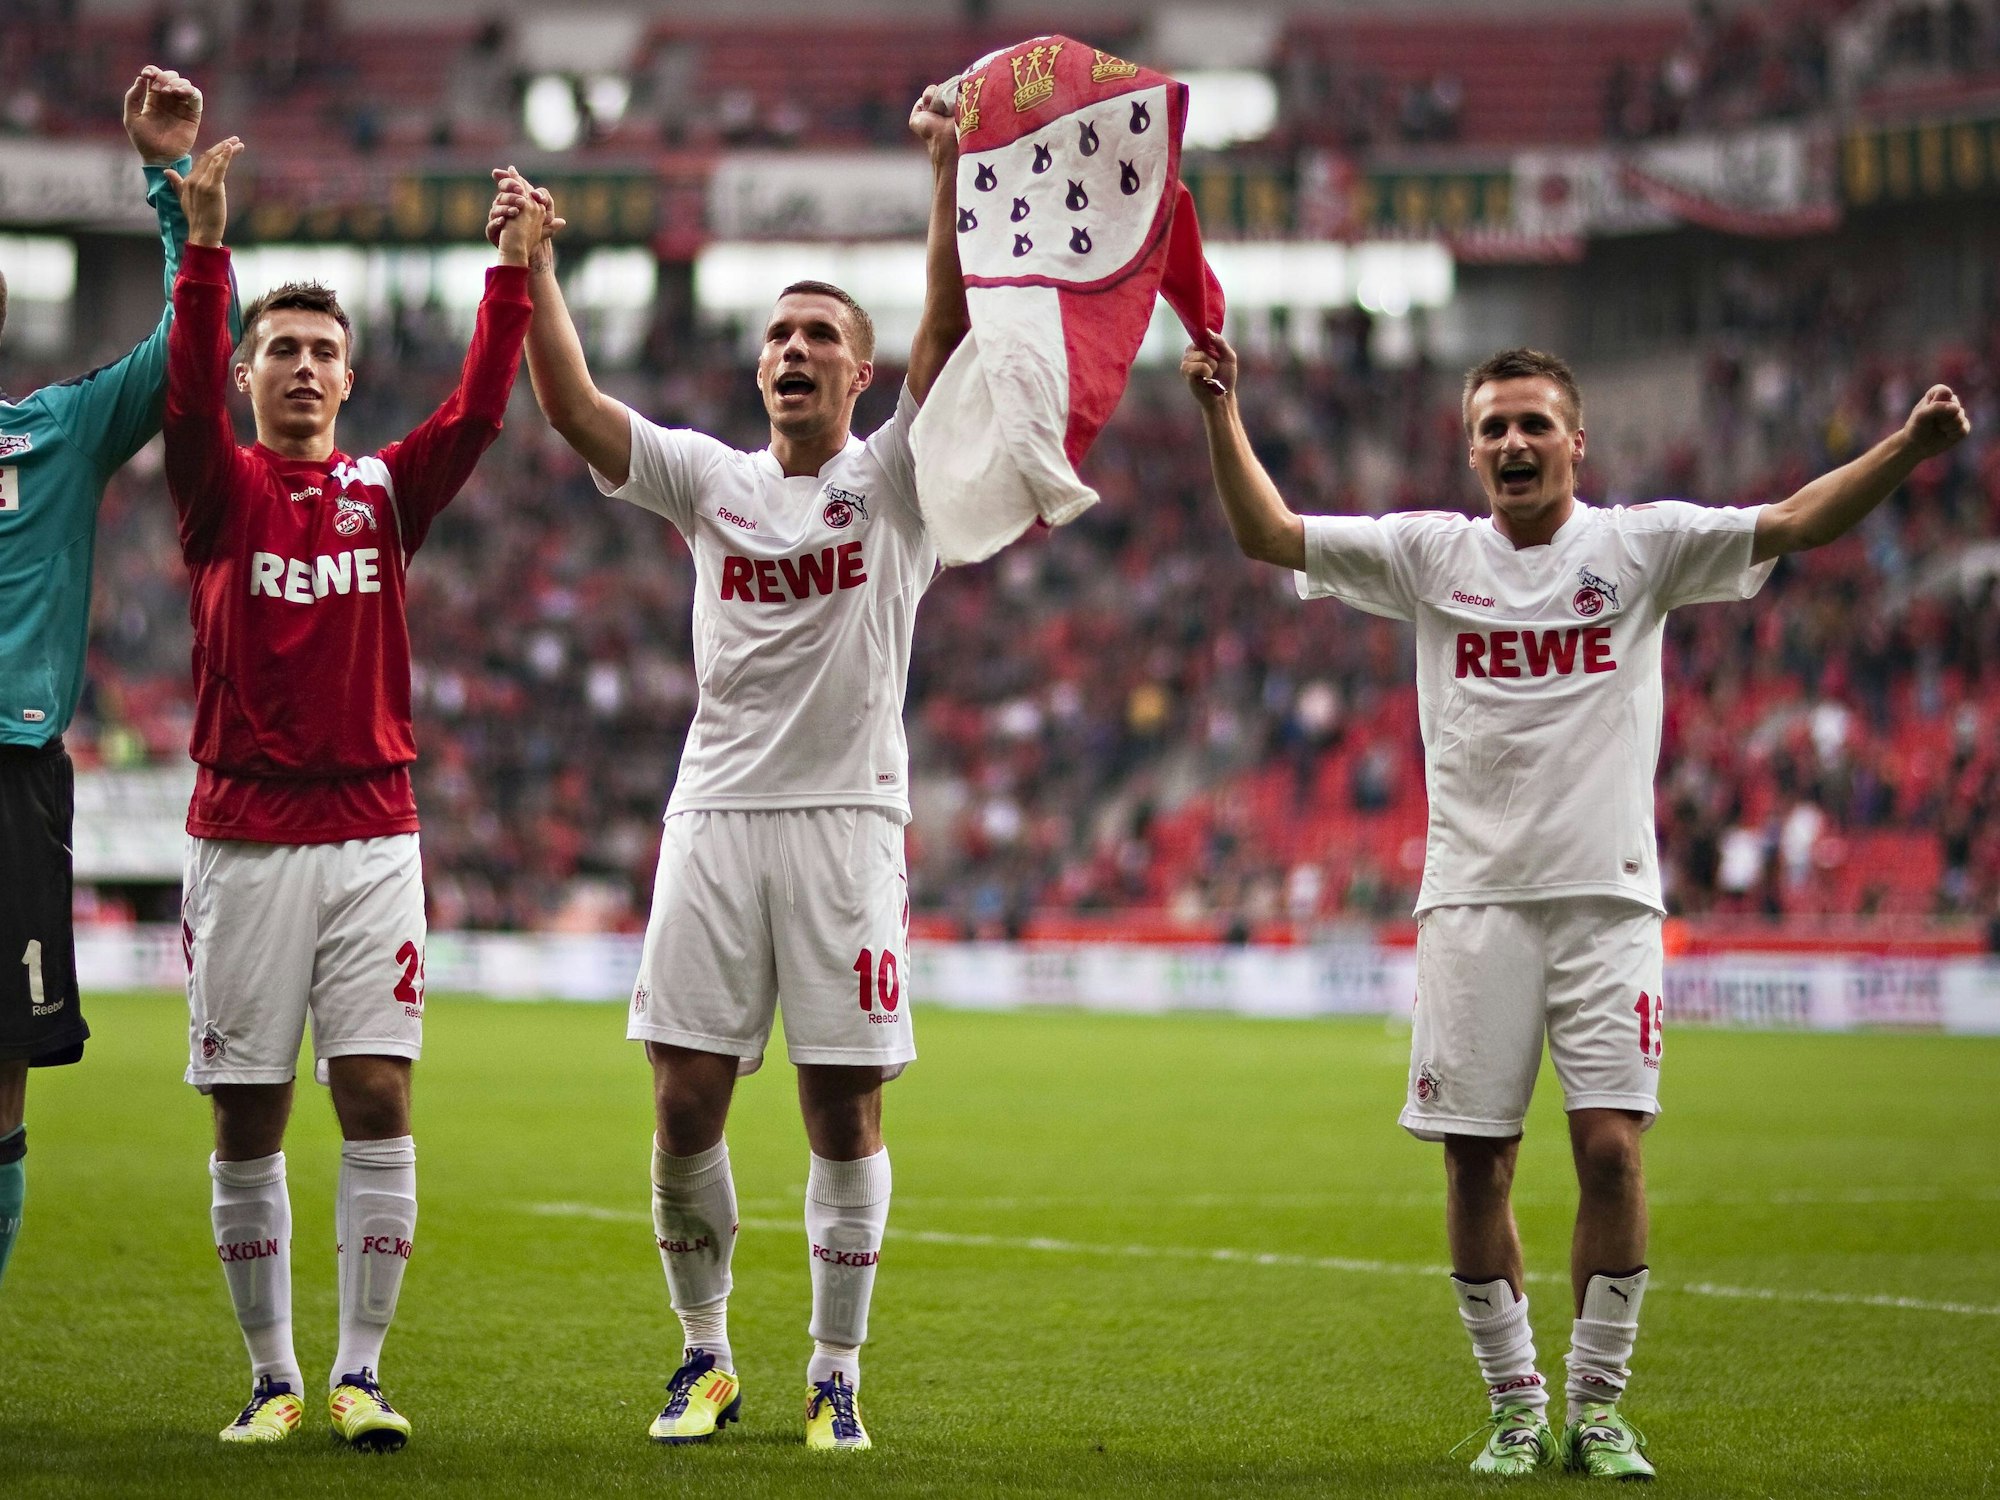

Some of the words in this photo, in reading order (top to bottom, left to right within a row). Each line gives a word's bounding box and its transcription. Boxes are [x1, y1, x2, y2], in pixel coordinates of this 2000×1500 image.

[716, 506, 758, 531] Reebok
[720, 540, 868, 603] REWE
[1451, 590, 1496, 608] Reebok
[1455, 627, 1617, 679] REWE
[21, 939, 45, 1004] 1
[393, 940, 425, 1006] 2
[853, 948, 900, 1012] 10
[868, 1012, 900, 1024] Reebo
